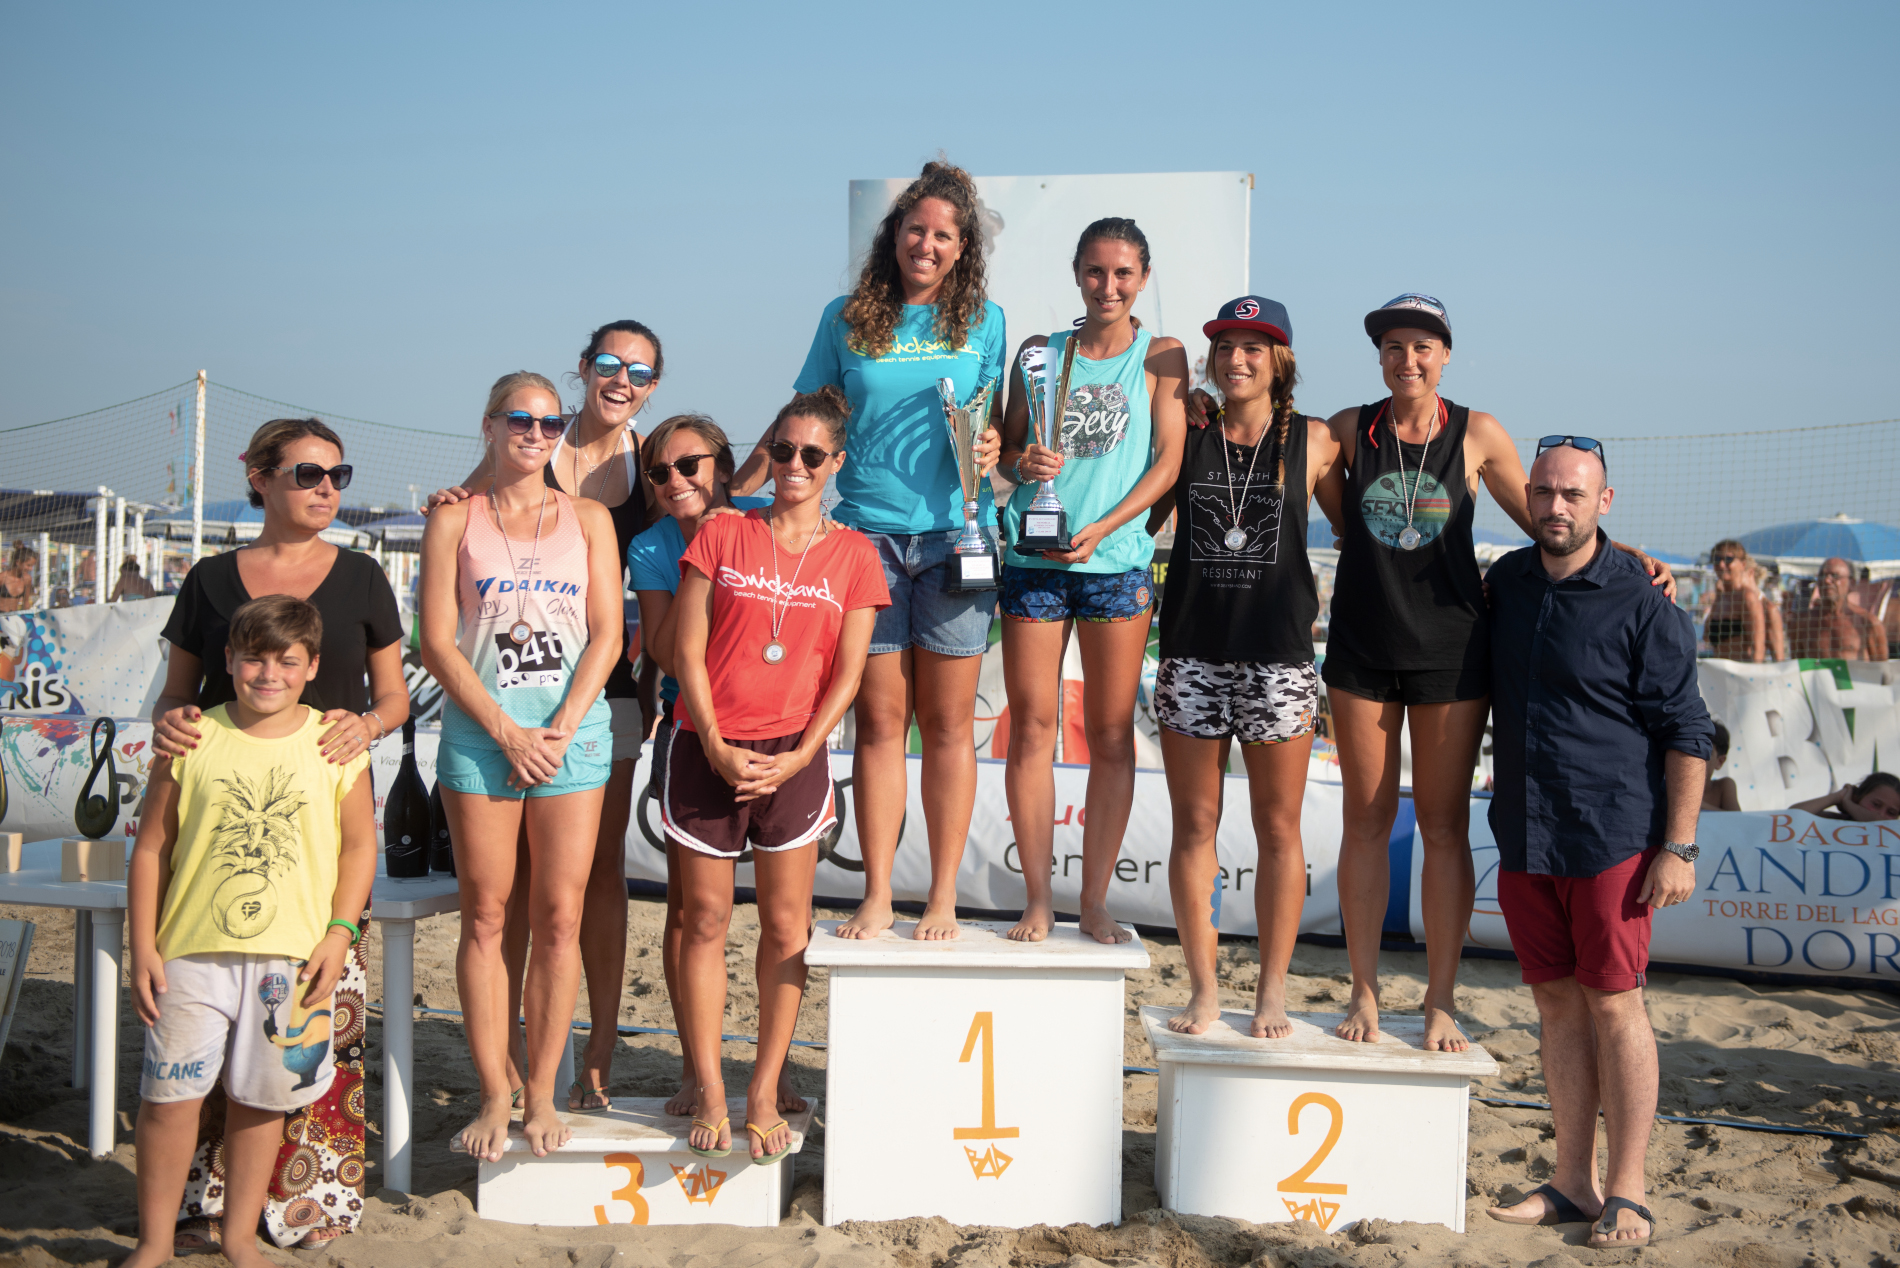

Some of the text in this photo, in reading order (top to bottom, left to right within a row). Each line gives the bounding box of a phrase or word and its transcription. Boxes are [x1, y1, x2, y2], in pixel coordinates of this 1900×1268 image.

[1062, 391, 1129, 454] Sexy
[1207, 471, 1270, 483] ST BARTH
[1361, 499, 1407, 518] SEXY
[1202, 566, 1263, 580] RÉSISTANT
[498, 579, 581, 597] DAIKIN
[733, 590, 756, 599] beach
[778, 599, 817, 609] equipment
[1703, 898, 1899, 927] TORRE DEL LAG
[953, 1011, 1020, 1141] 1
[1277, 1092, 1348, 1195] 2
[594, 1142, 650, 1226] 3
